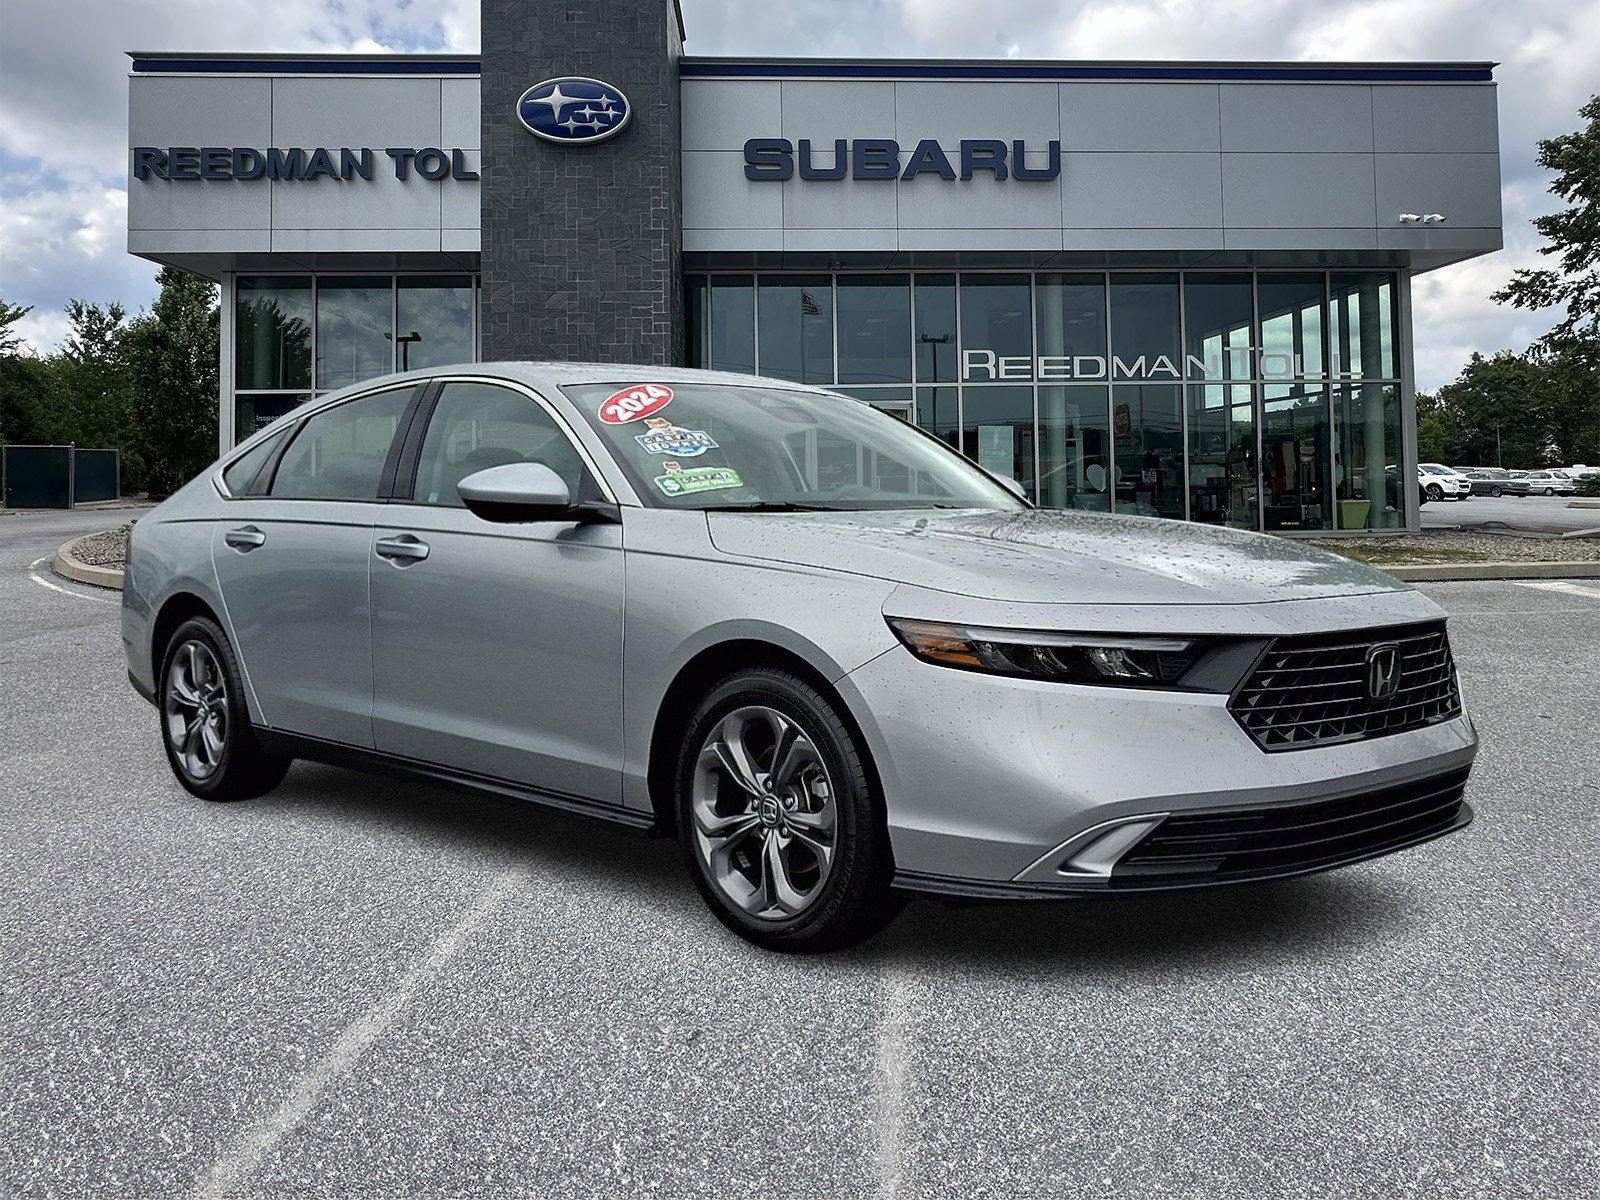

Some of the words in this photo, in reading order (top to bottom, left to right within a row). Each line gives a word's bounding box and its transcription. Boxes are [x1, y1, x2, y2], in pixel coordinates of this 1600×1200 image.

[133, 147, 372, 180] REEDMAN
[743, 138, 1062, 181] SUBARU
[606, 385, 669, 421] 2024
[643, 432, 709, 444] CARFAX
